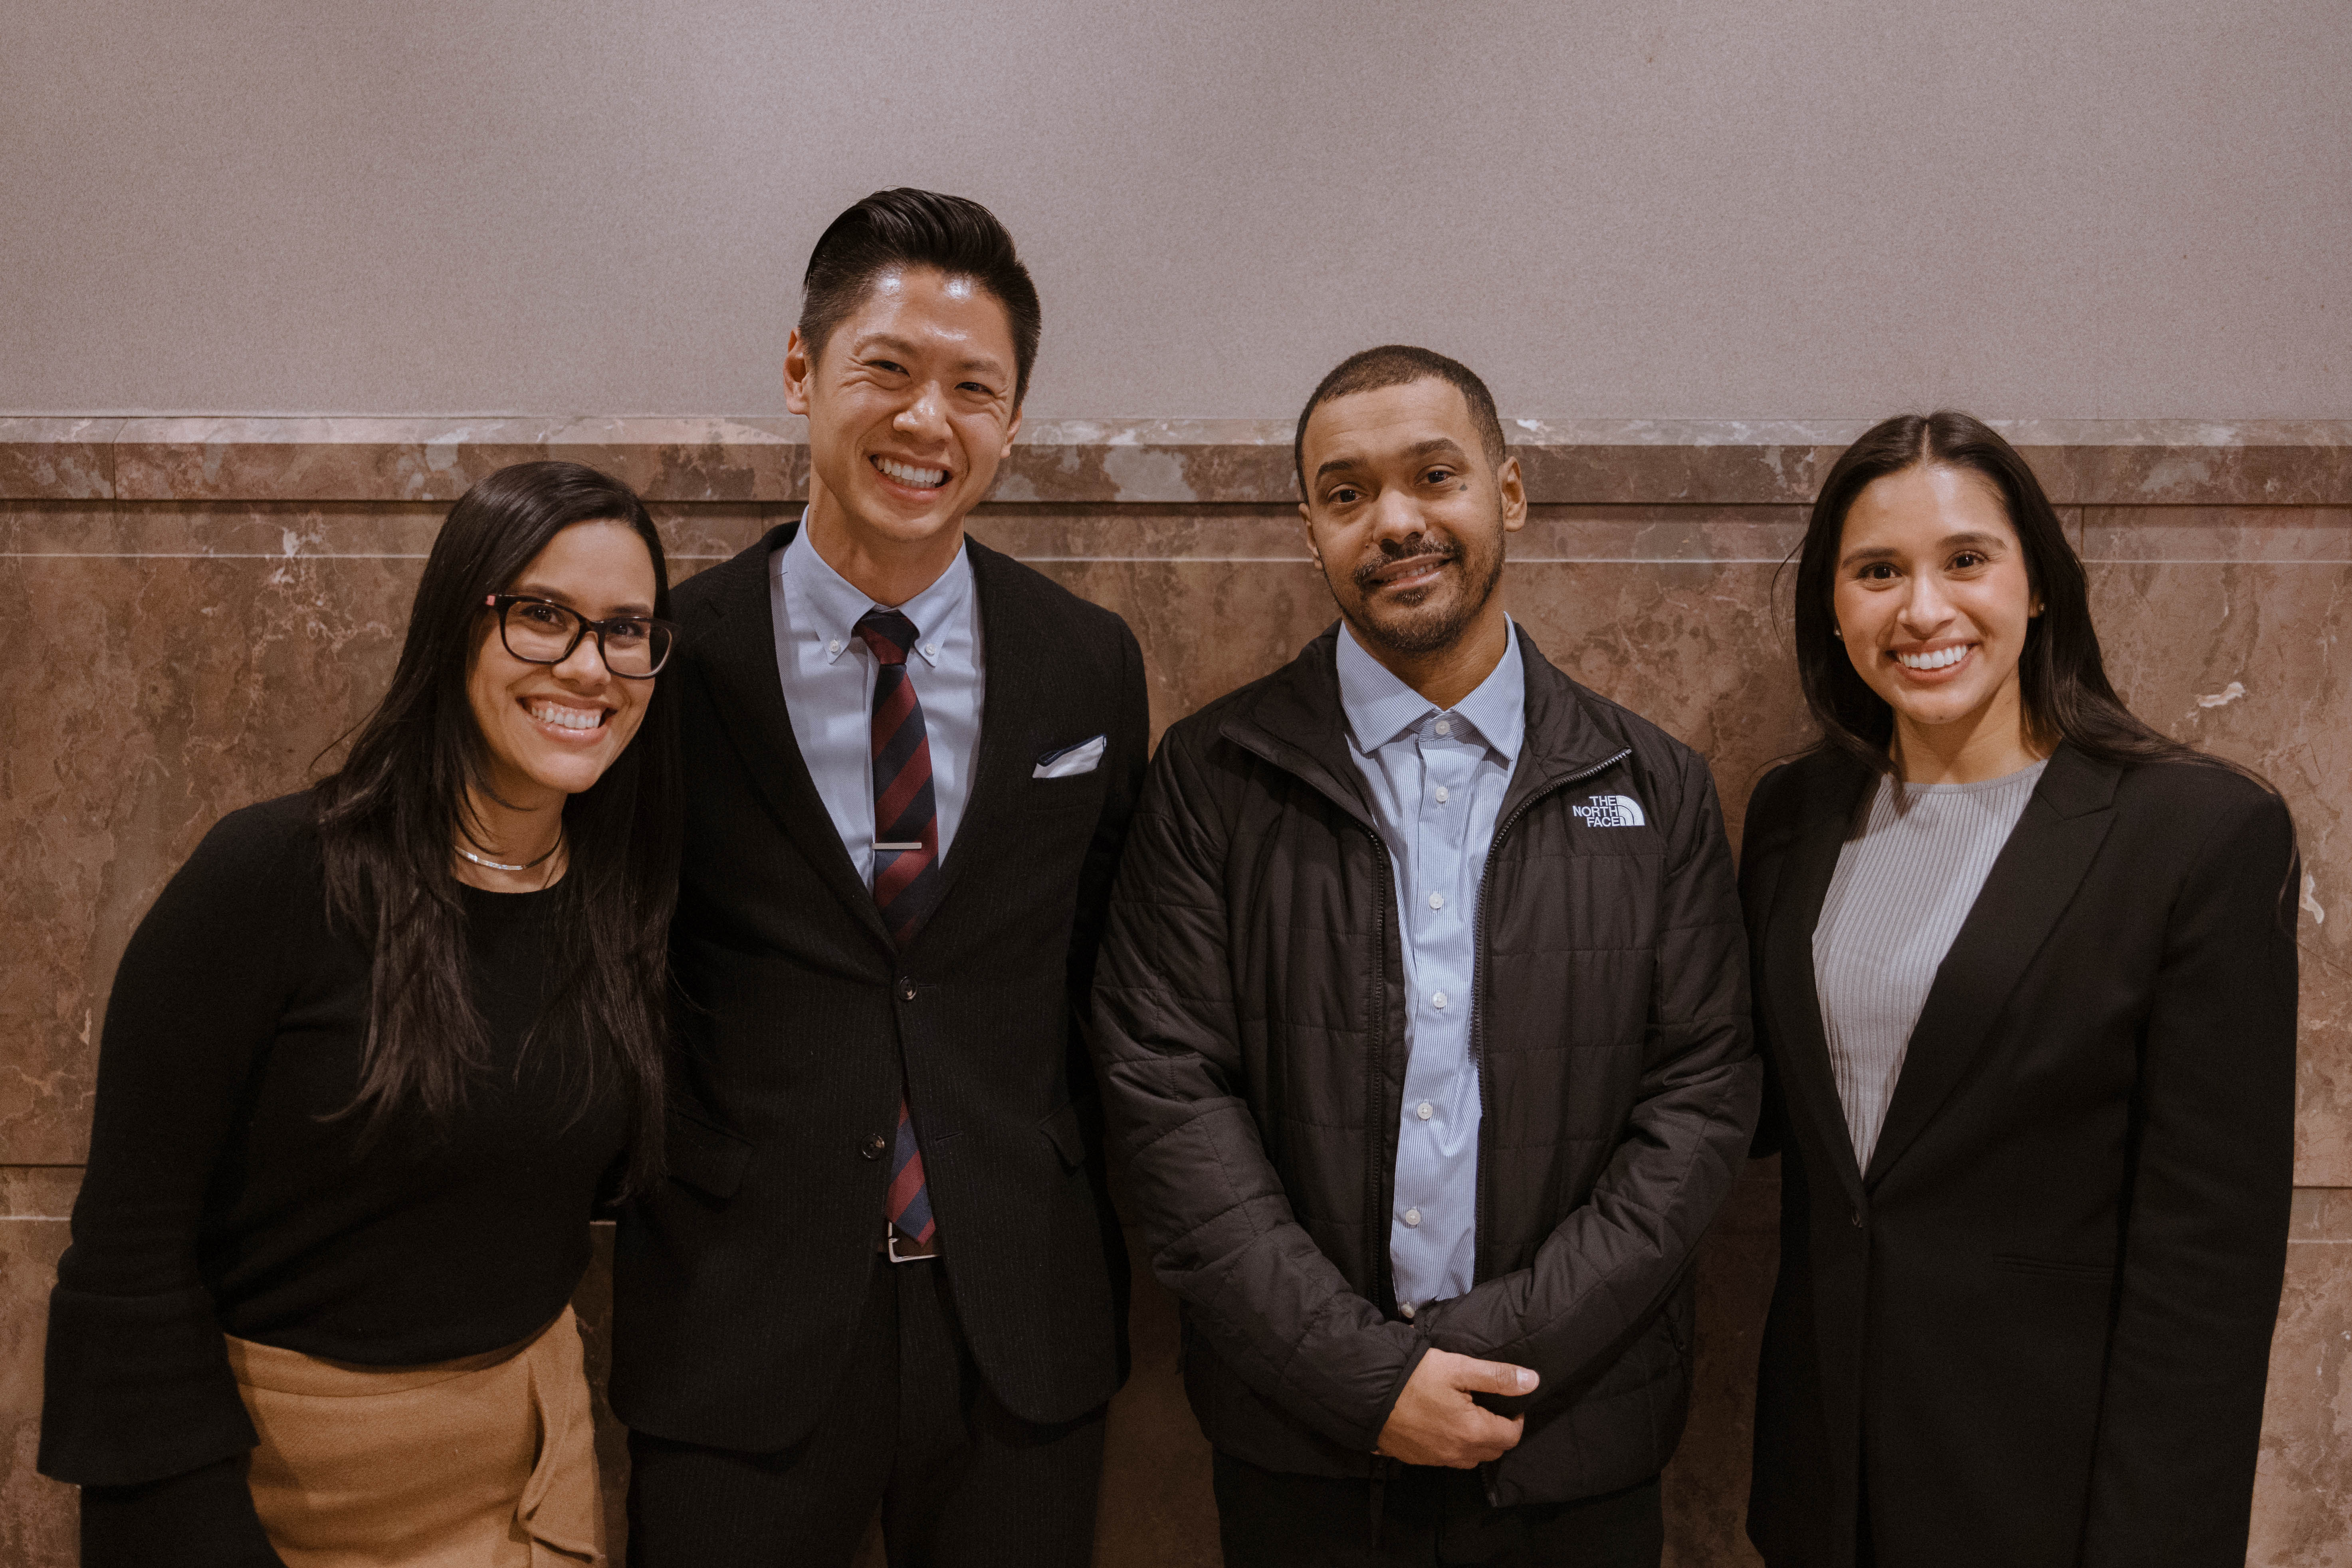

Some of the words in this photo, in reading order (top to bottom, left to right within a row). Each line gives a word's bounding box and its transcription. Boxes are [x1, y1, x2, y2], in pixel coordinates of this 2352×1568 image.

[1589, 795, 1617, 806] THE
[1572, 805, 1619, 817] NORTH
[1586, 817, 1620, 827] FACE
